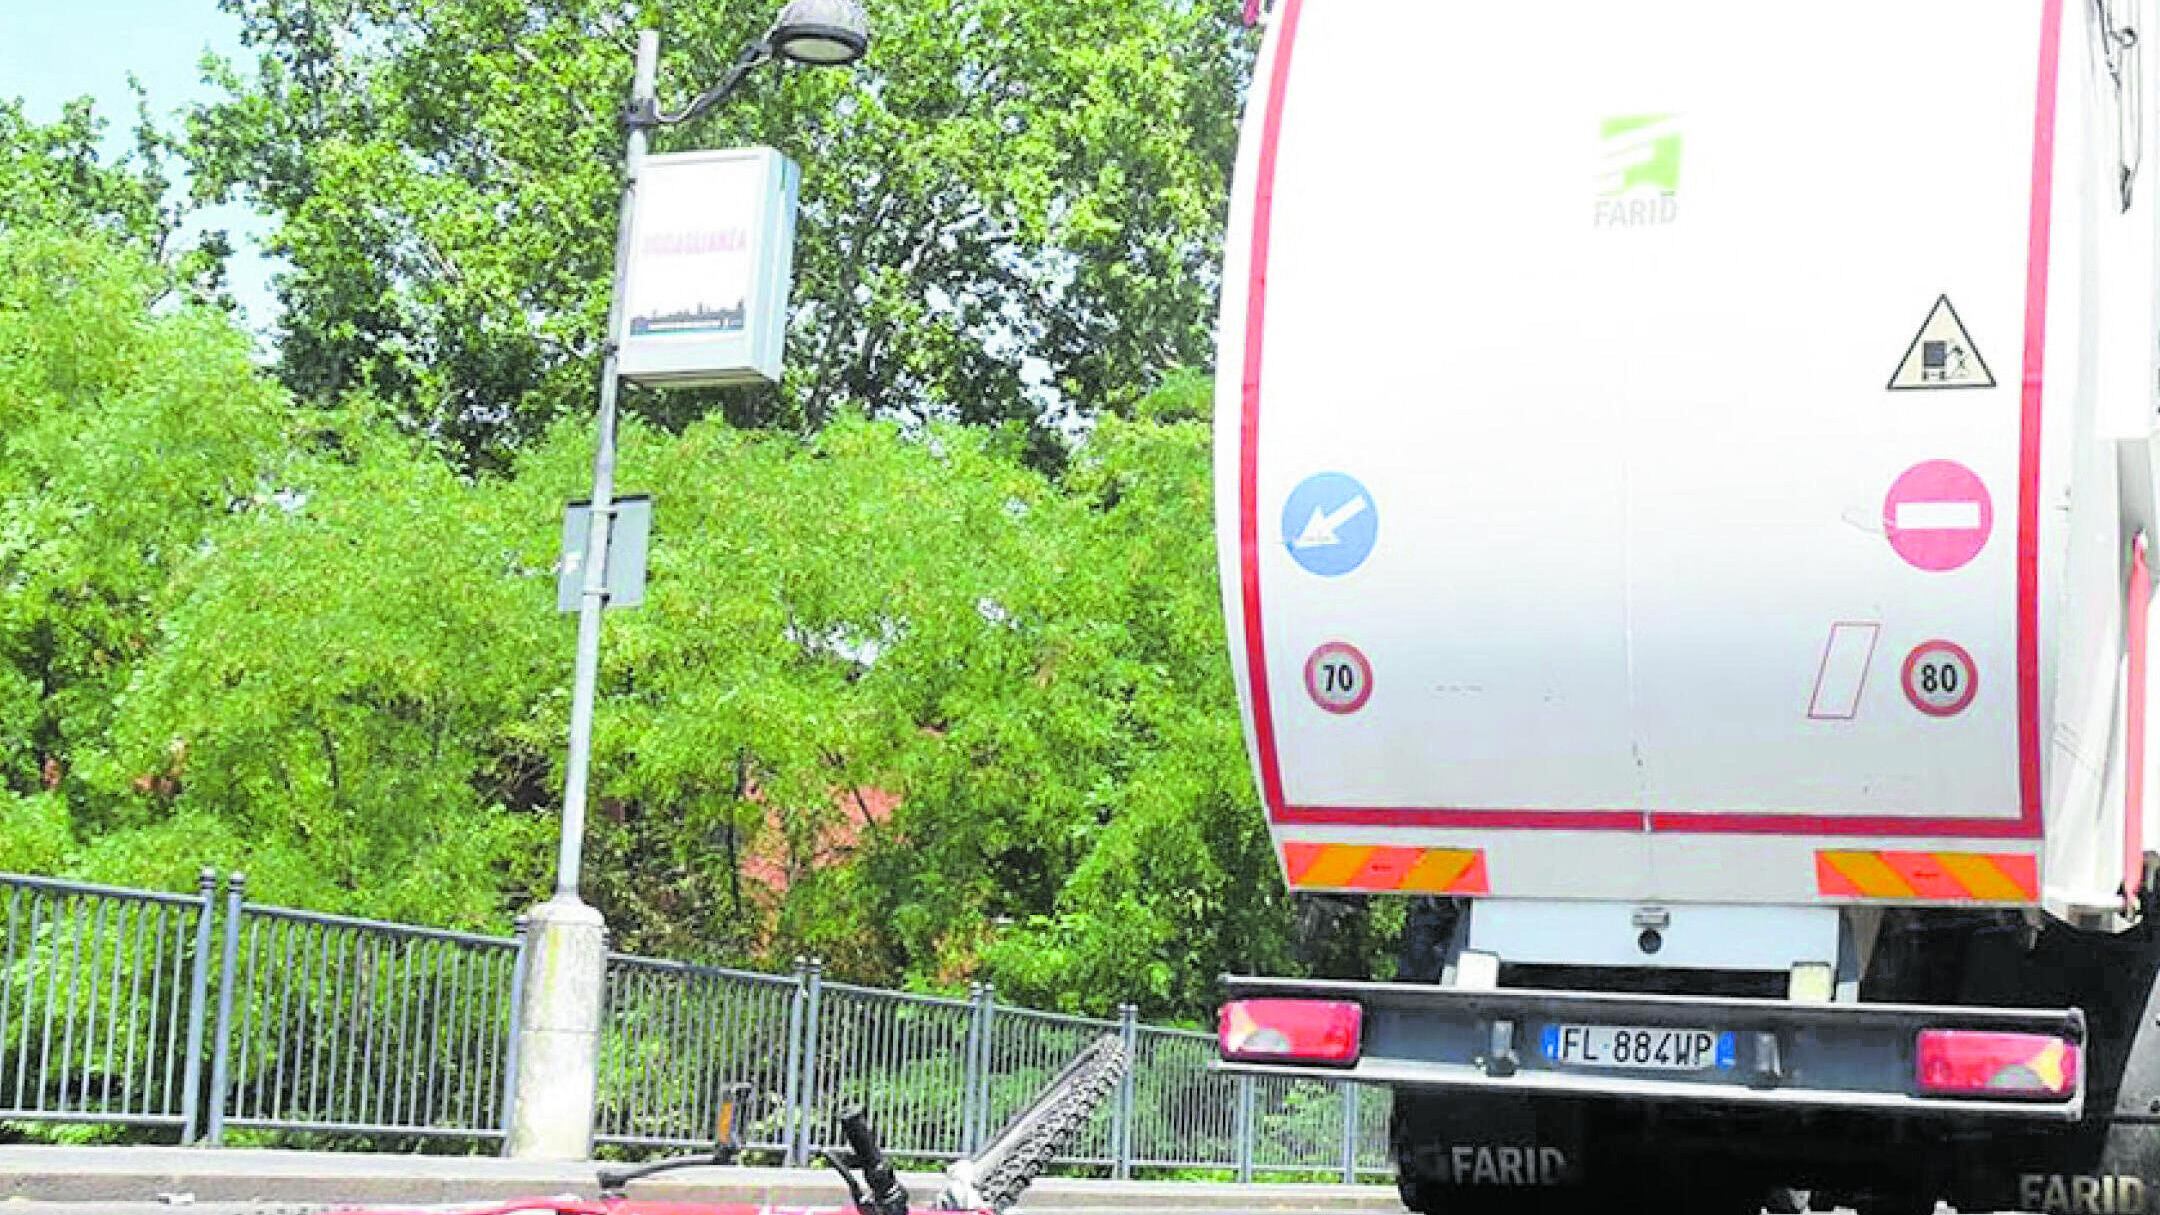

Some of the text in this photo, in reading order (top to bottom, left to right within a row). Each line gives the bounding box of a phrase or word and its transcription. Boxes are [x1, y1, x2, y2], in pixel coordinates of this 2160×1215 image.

[1593, 198, 1678, 226] FARID
[1323, 664, 1353, 692] 70
[1921, 663, 1958, 692] 80
[1563, 1028, 1598, 1060] FL
[1612, 1030, 1712, 1066] 884WP
[1452, 1146, 1566, 1186] FARID
[2020, 1174, 2144, 1214] FARID
